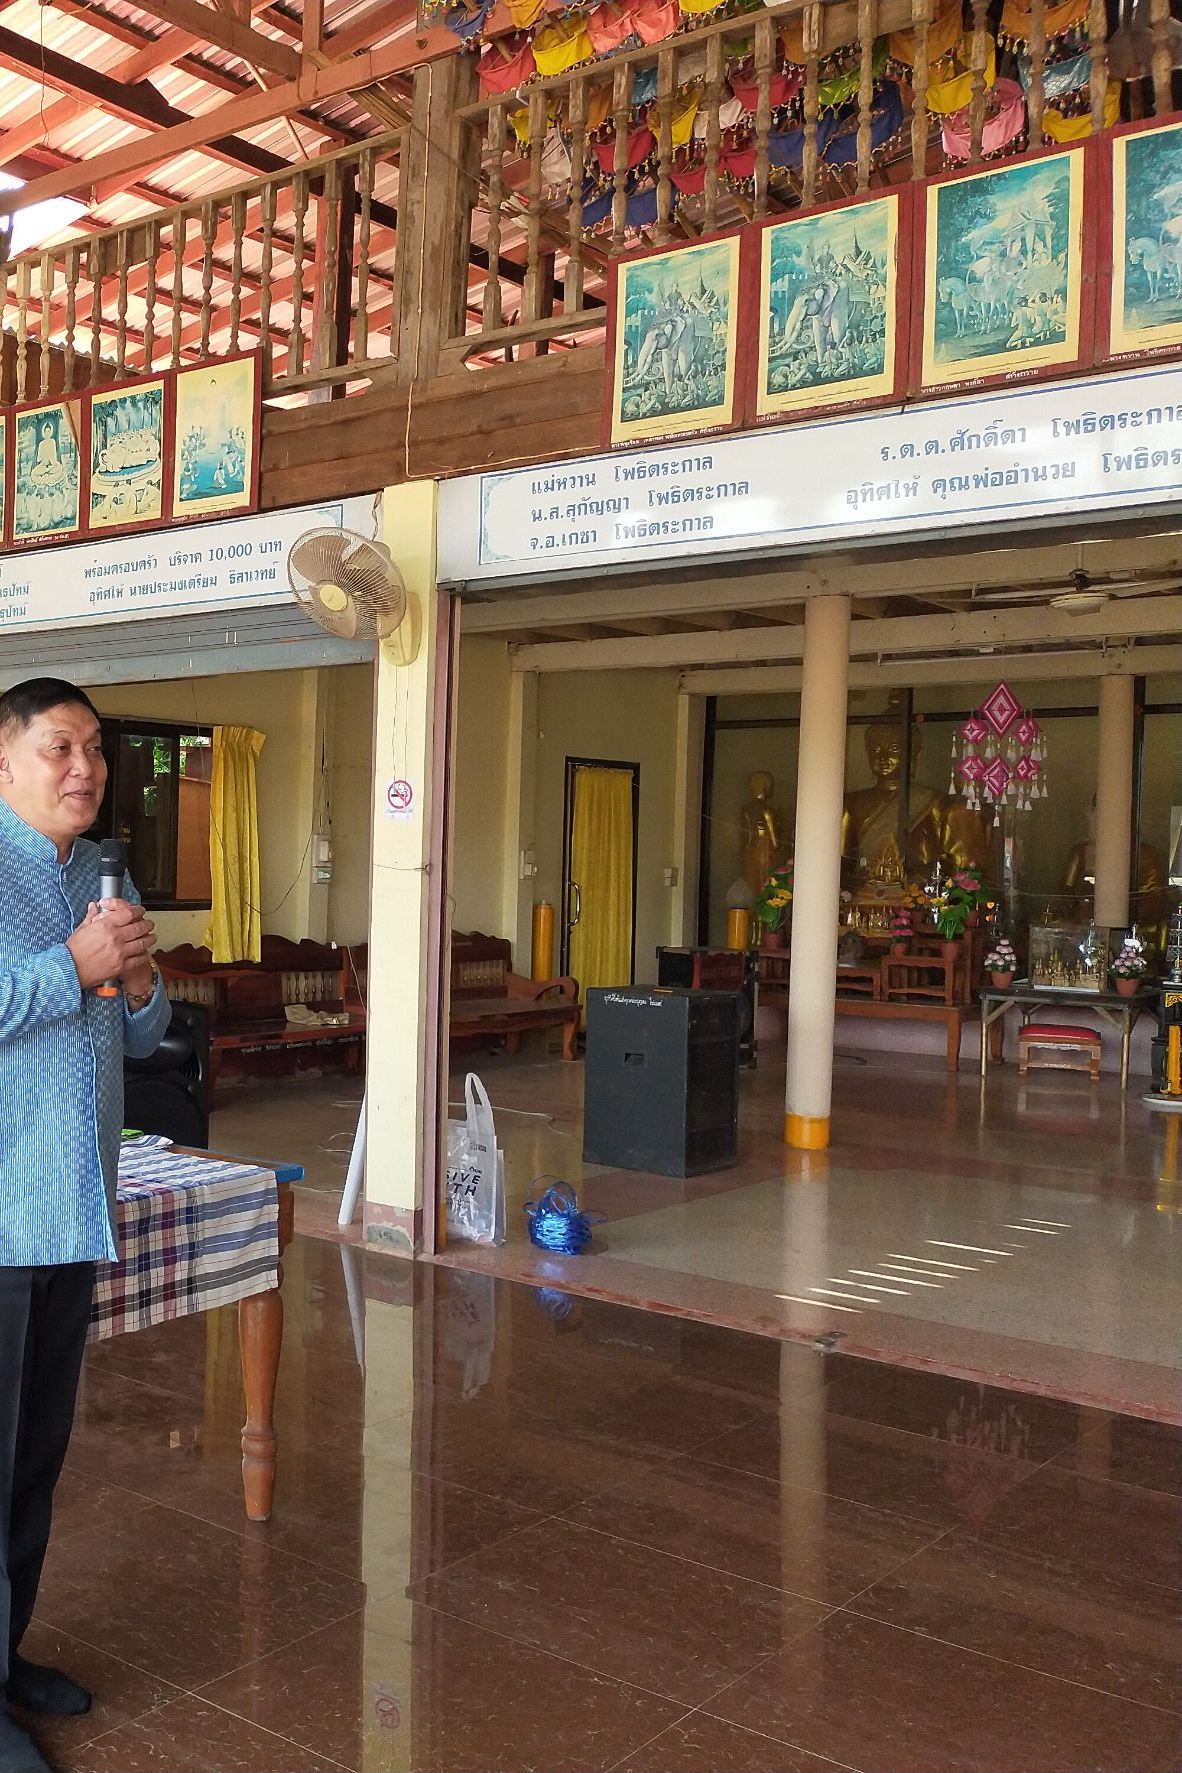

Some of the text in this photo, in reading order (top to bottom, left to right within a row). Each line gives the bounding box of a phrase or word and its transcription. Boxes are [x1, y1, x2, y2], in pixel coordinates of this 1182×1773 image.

[531, 455, 714, 495] แม่หวาน โพธิตระกาล
[931, 461, 1076, 499] คุณพ่ออำนวย
[531, 480, 749, 523] น.ส.สุกัญญา โพธิตระกาล
[530, 514, 714, 551] จ.อ.เกชา โพธิตระกาล
[84, 540, 282, 578] พร้อมครอบครัว บริจาค 10,000 บาท
